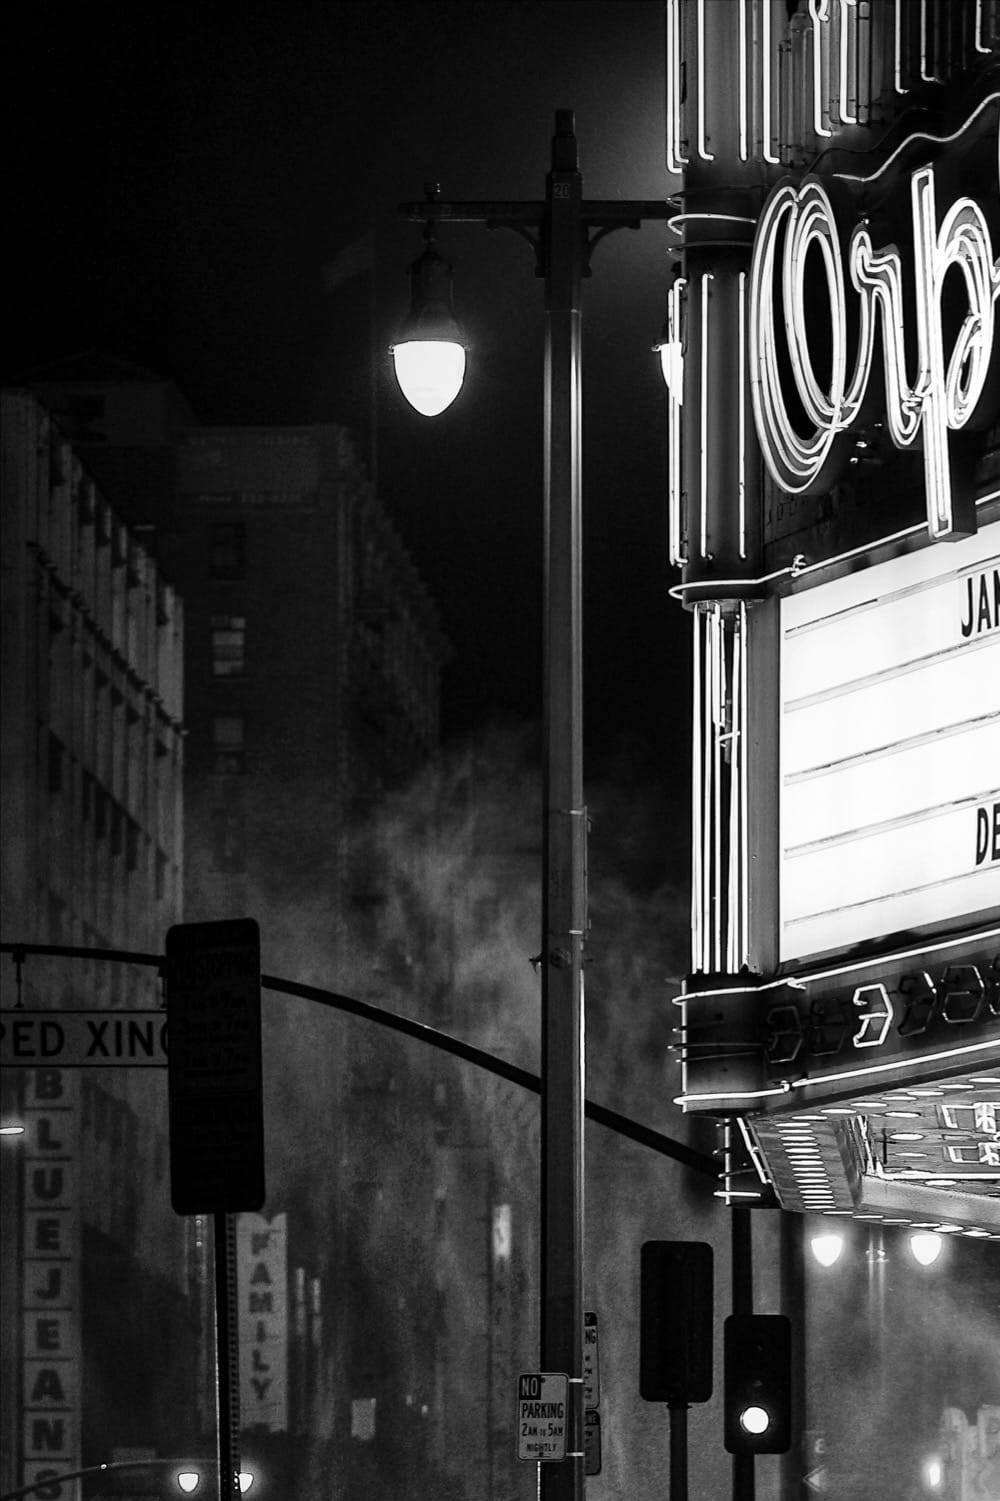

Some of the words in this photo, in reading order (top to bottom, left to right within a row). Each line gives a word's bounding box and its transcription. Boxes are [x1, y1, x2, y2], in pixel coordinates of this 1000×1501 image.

[0, 1021, 65, 1057] ED
[249, 1232, 275, 1402] FAMILY
[522, 1377, 538, 1396] NO
[522, 1403, 564, 1418] PARKING
[526, 1443, 557, 1452] NIGHTLY
